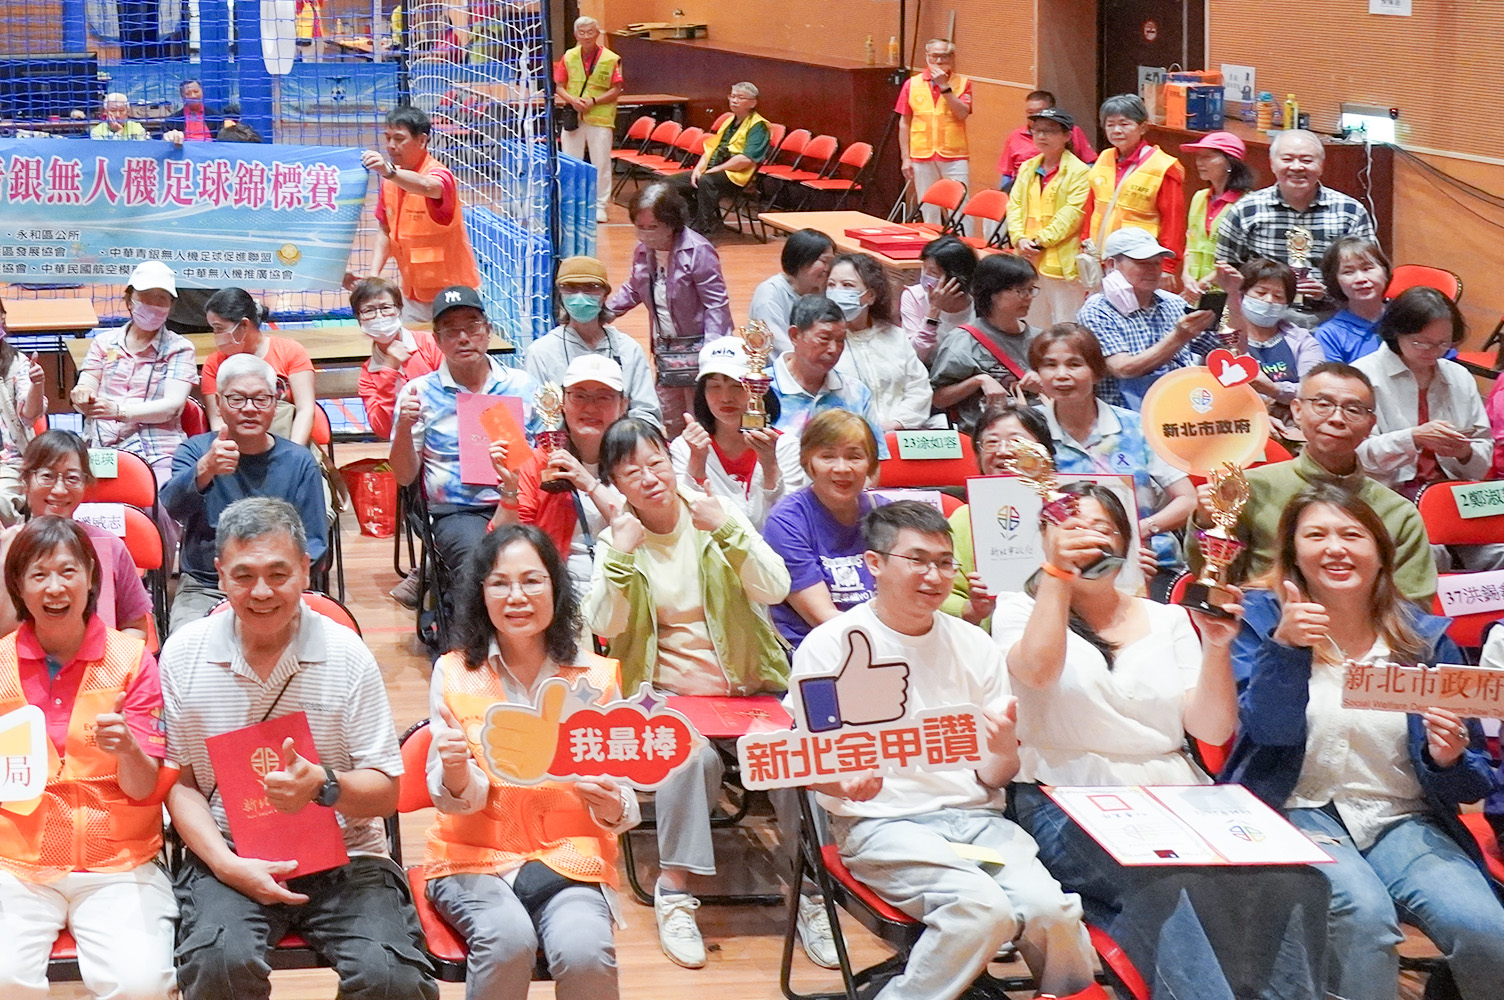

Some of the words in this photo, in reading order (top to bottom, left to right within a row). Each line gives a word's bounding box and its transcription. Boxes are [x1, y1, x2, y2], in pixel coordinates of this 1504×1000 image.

[1162, 418, 1251, 439] 新北市政府
[1460, 487, 1504, 508] 2鄭淑
[1345, 662, 1504, 702] 新北市政府
[569, 725, 678, 763] 我最棒
[746, 713, 982, 782] 新北金甲讚
